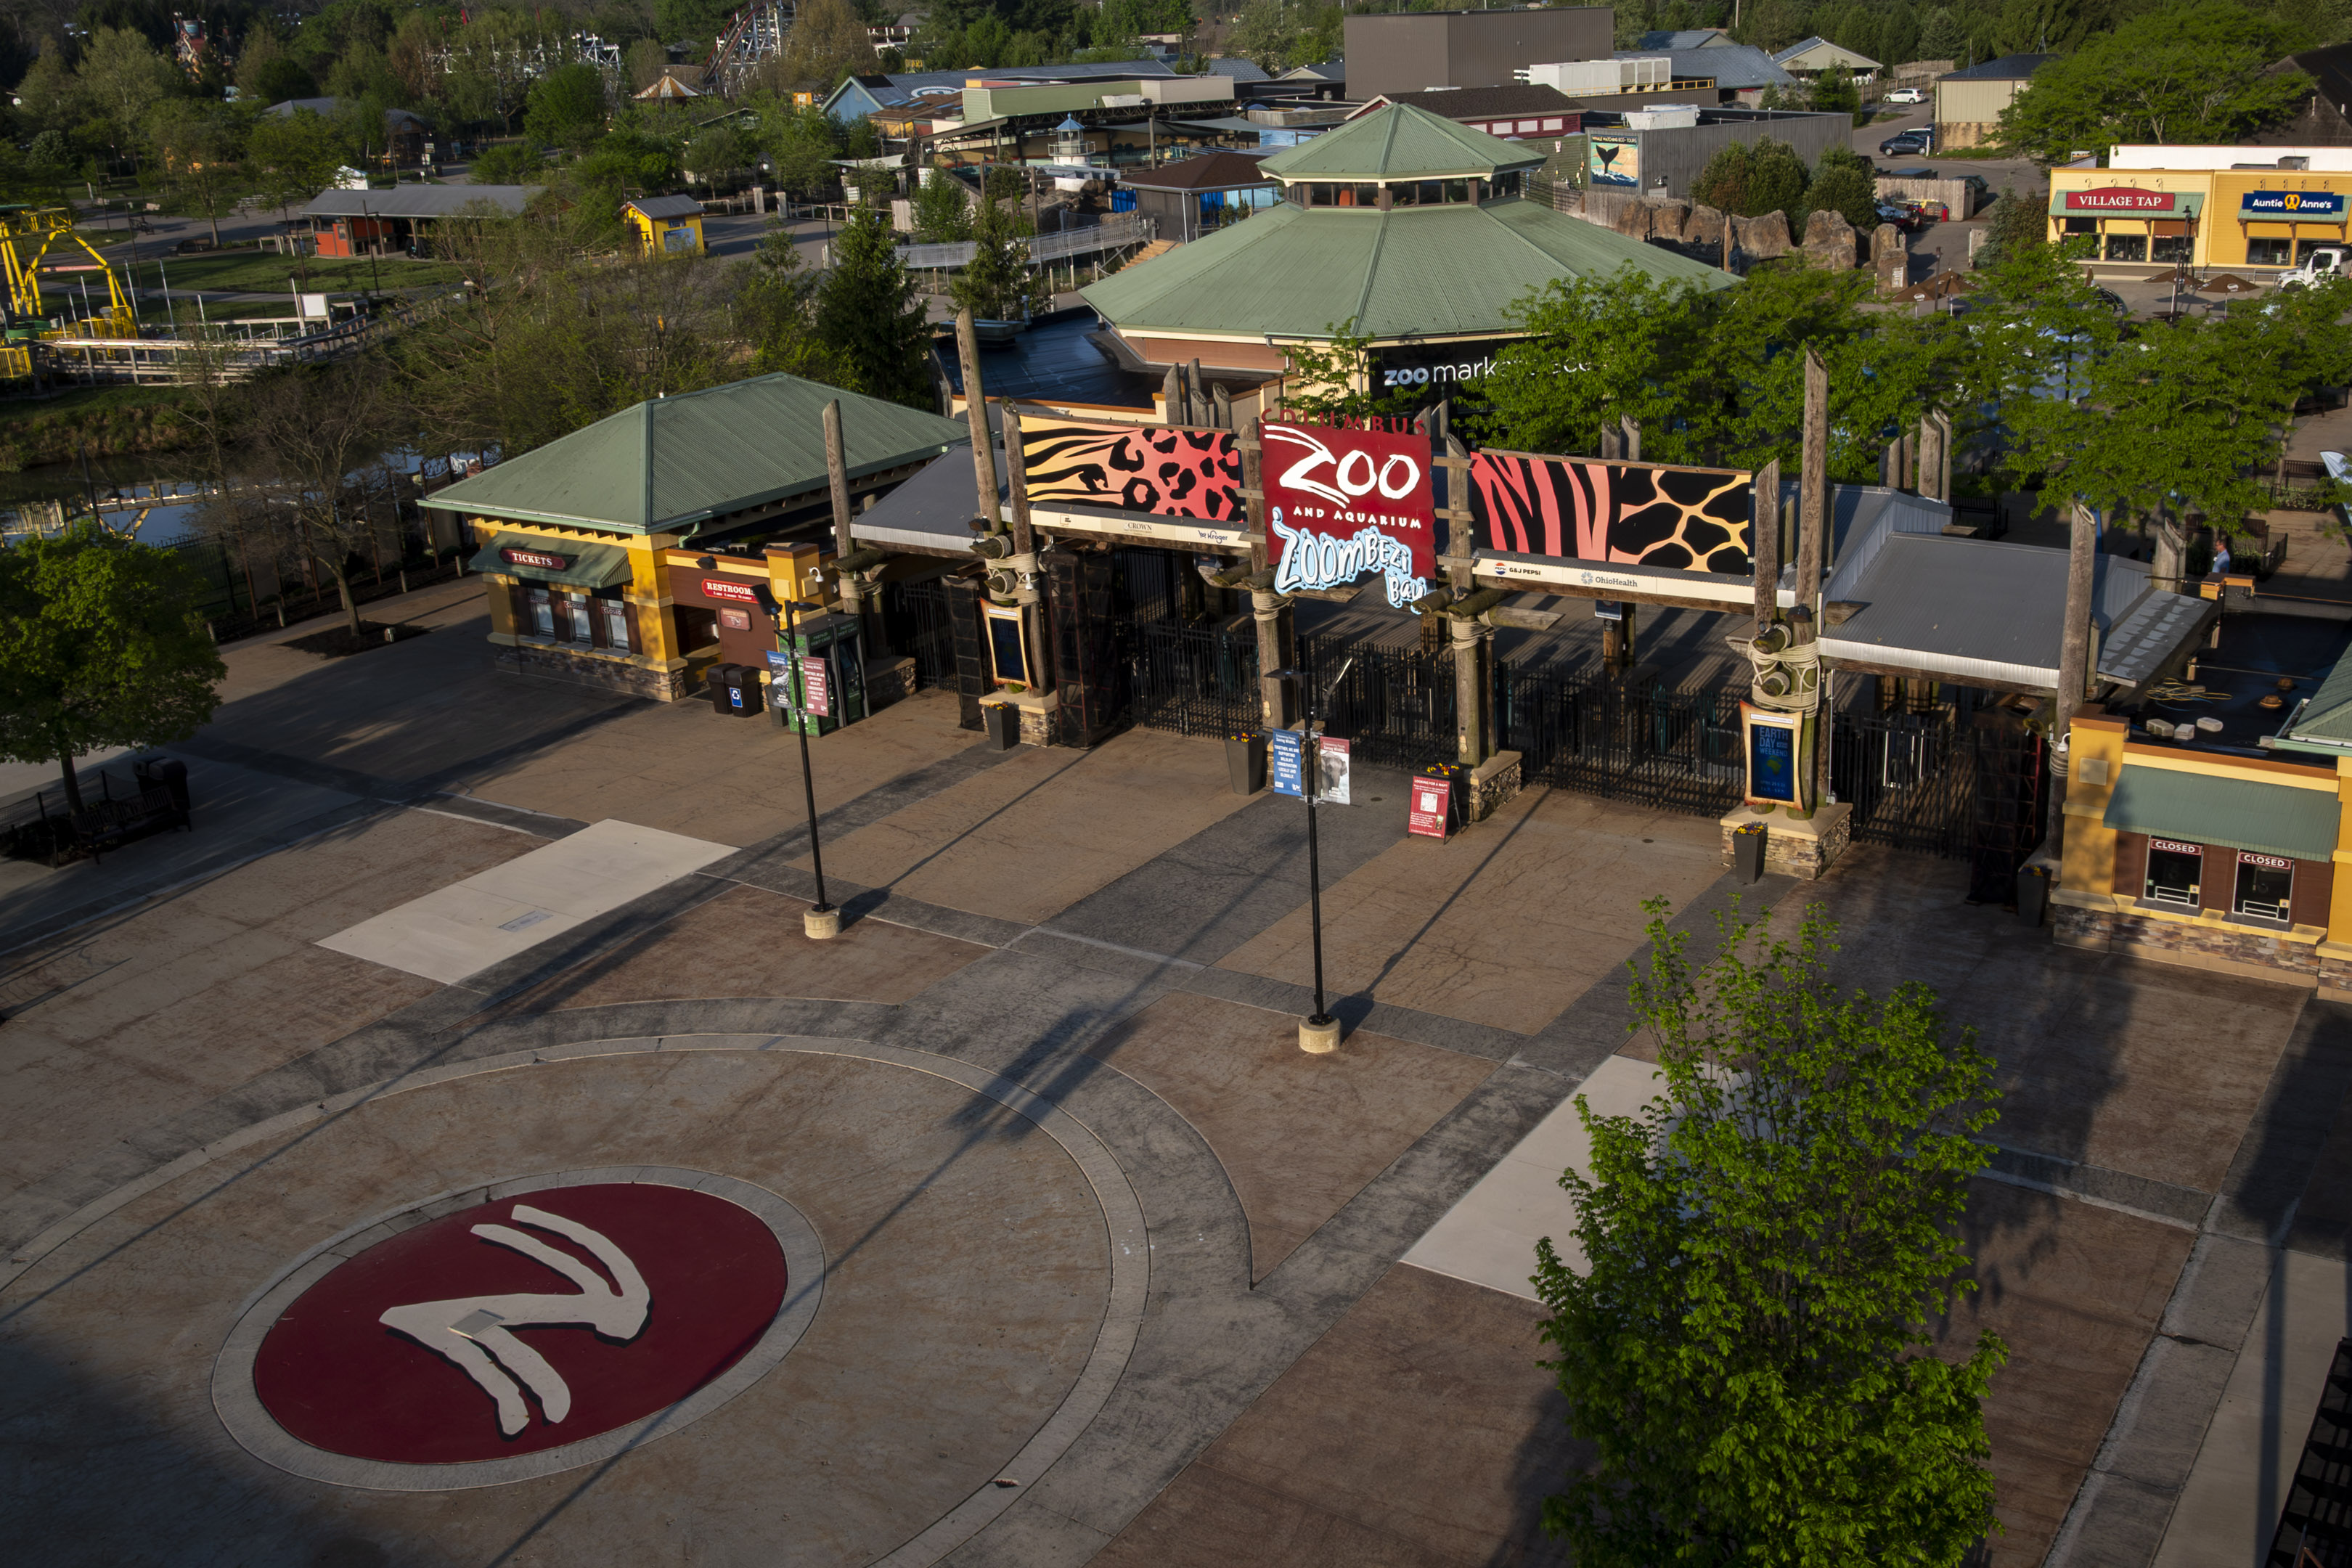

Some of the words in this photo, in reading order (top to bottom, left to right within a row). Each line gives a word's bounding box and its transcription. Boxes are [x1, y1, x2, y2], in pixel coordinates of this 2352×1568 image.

[2078, 195, 2133, 206] VILLAGE
[2136, 197, 2162, 207] TAP
[2252, 199, 2284, 208] Auntie
[2300, 200, 2332, 209] Anne's
[1384, 367, 1429, 386] zoo
[1261, 407, 1426, 437] COLUMBUS
[1264, 425, 1421, 510] ZOO
[1293, 506, 1326, 519] AND
[1333, 510, 1422, 530] AQUARIUM
[1127, 522, 1153, 531] CROWN
[1207, 530, 1228, 544] Kroger
[512, 552, 552, 566] TICKETS
[1595, 576, 1638, 588] OhioHealth
[1759, 727, 1789, 740] EARTH
[1759, 737, 1776, 748] DAY
[1759, 747, 1788, 757] WEEKEND
[2155, 841, 2196, 854] CLOSED
[2244, 854, 2285, 867] CLOSED
